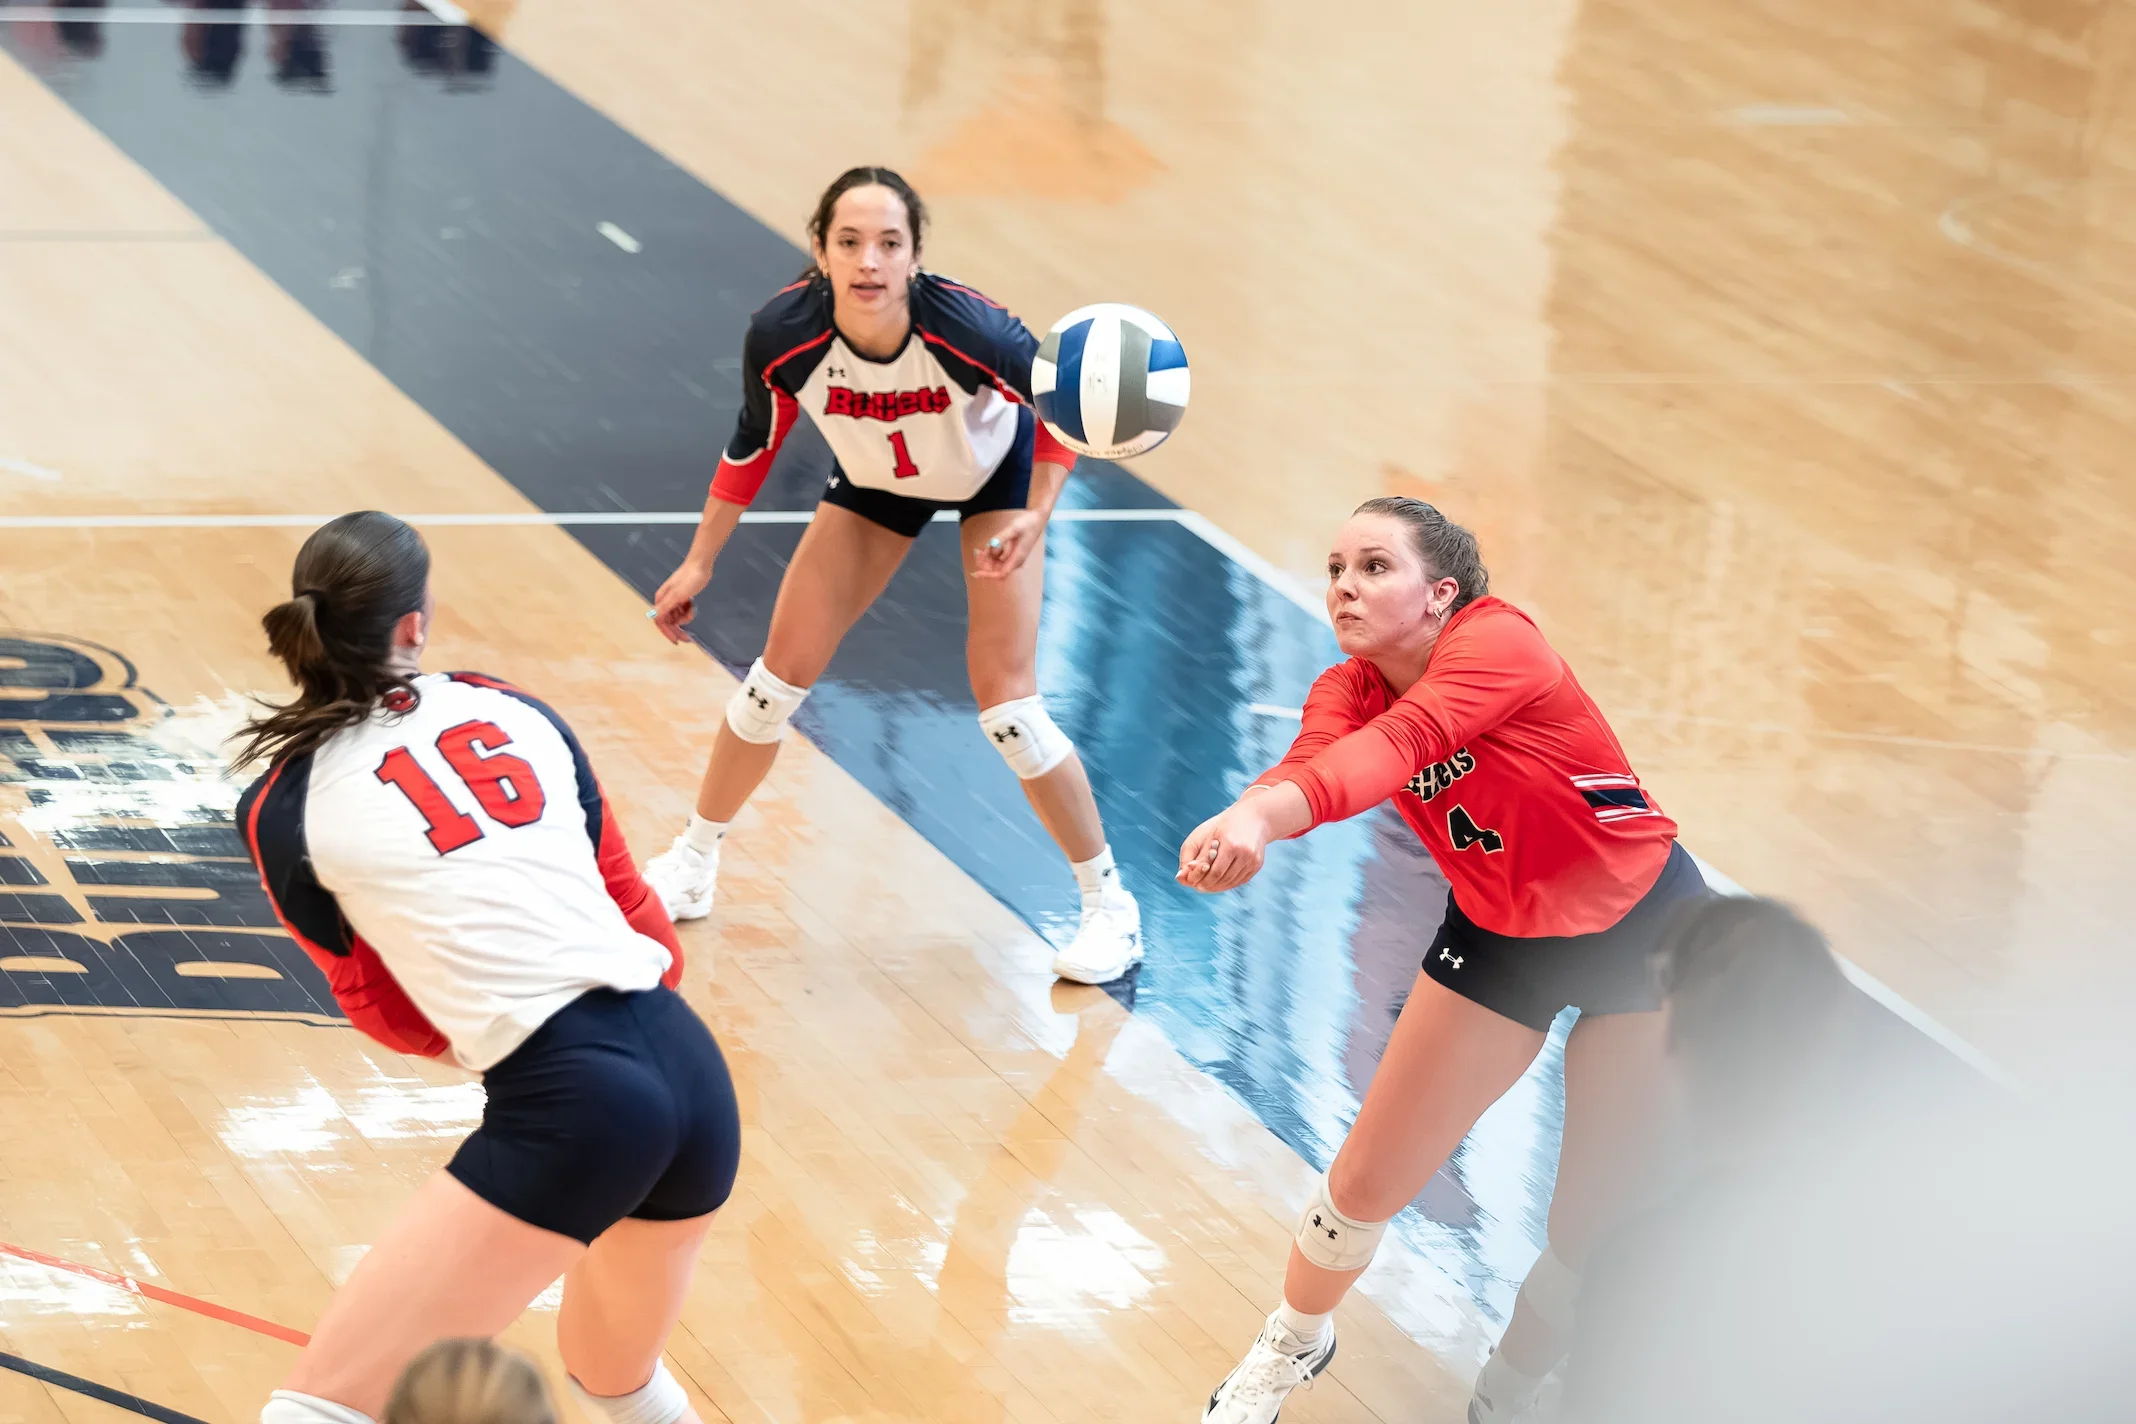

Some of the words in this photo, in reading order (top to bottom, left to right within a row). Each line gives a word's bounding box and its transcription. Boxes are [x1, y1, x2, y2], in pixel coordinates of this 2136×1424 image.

[824, 386, 951, 421] Bullets
[887, 430, 919, 478] 1
[373, 719, 547, 856] 16
[1446, 803, 1505, 855] 4
